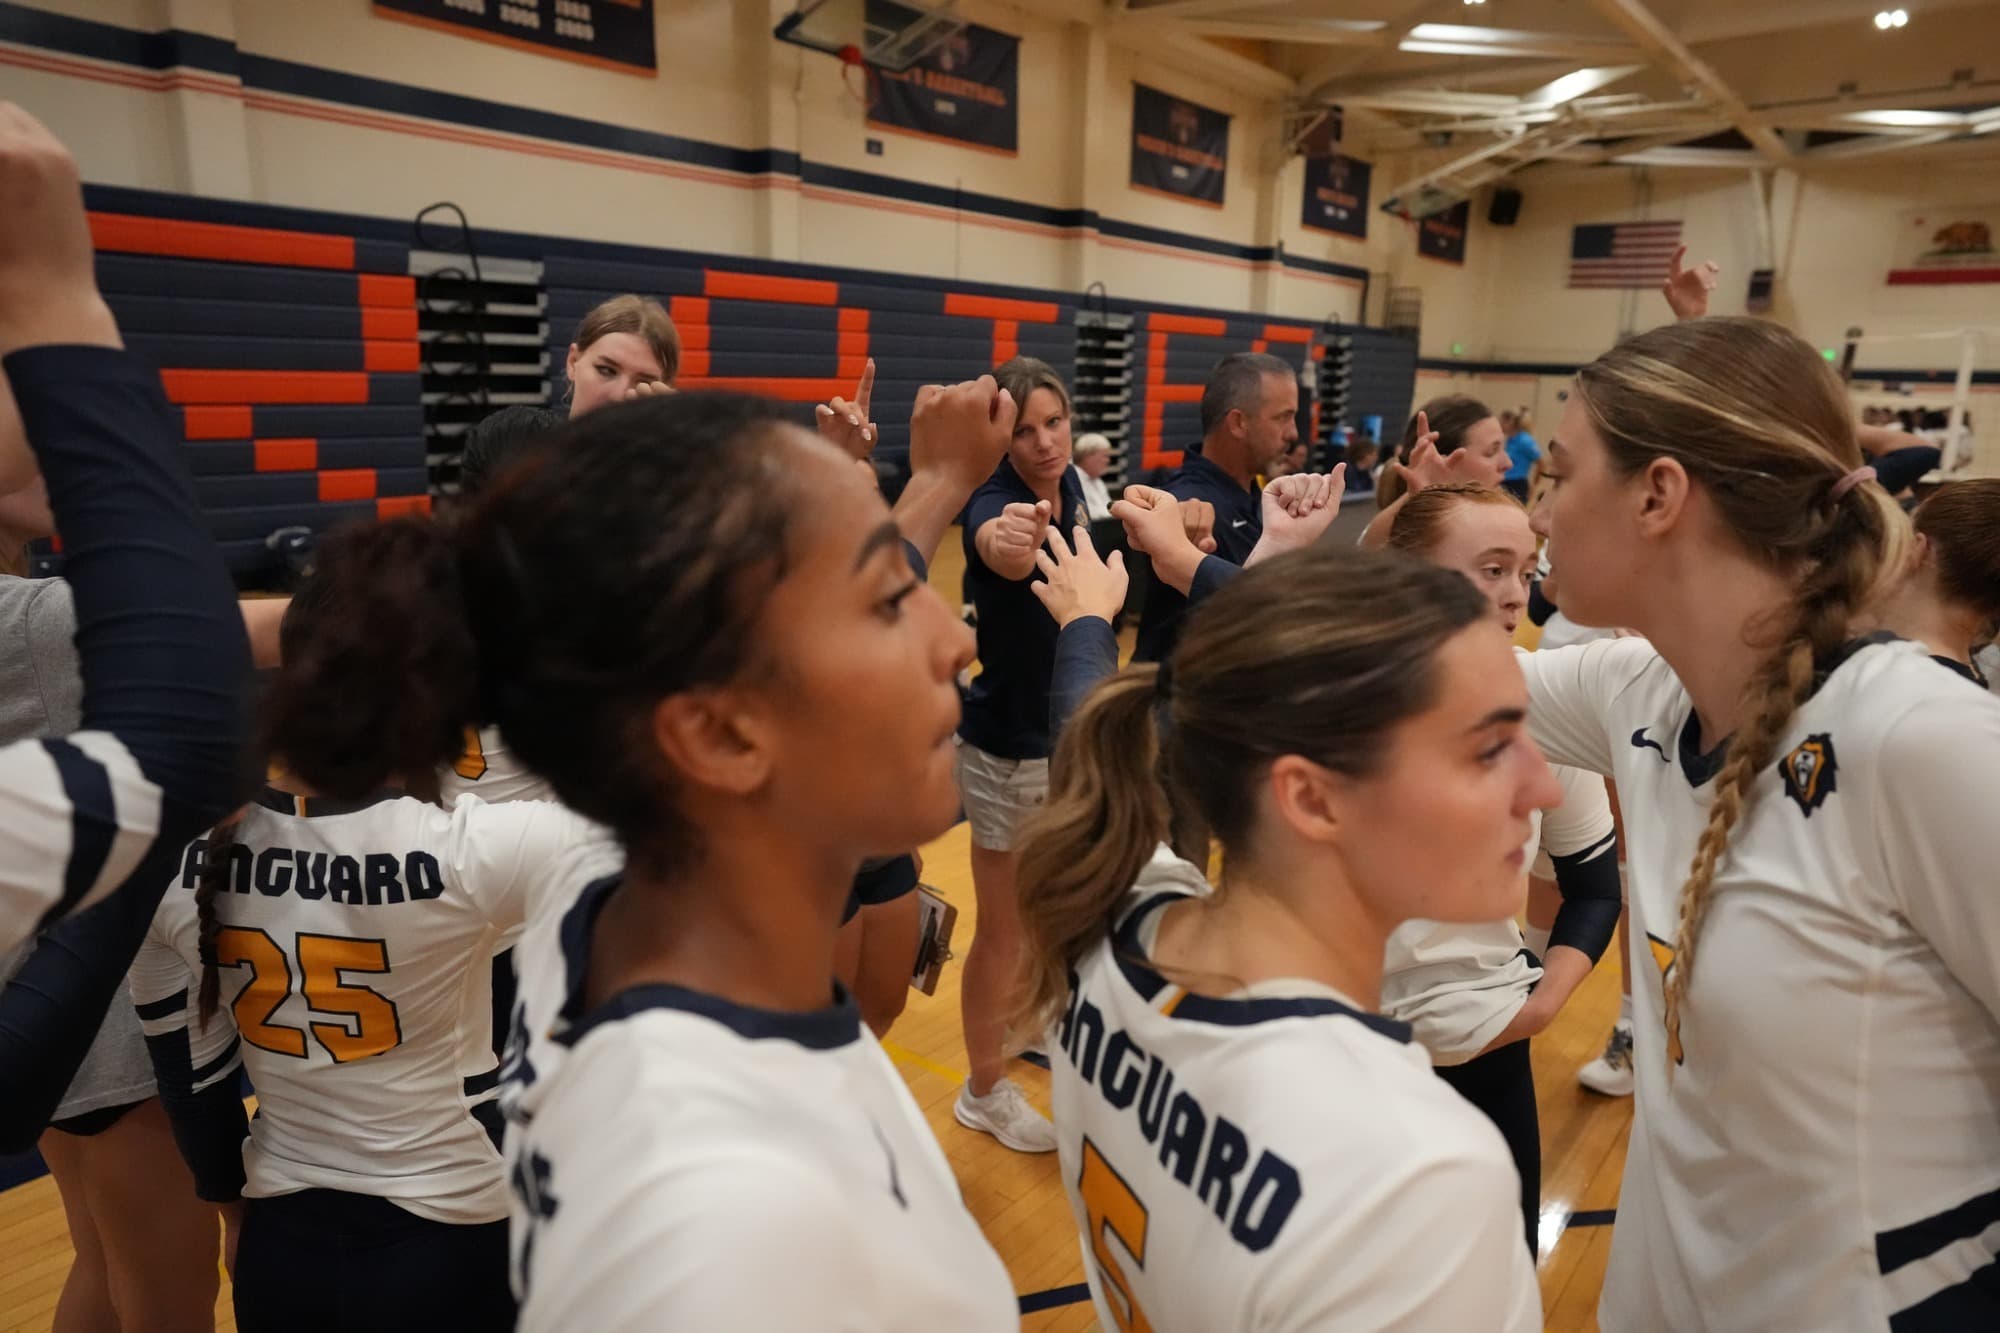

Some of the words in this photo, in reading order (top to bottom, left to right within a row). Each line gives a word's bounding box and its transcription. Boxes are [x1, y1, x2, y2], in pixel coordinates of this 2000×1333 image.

[181, 839, 445, 905] ANGUARD
[212, 924, 402, 1063] 25
[1055, 975, 1303, 1254] ANGUARD
